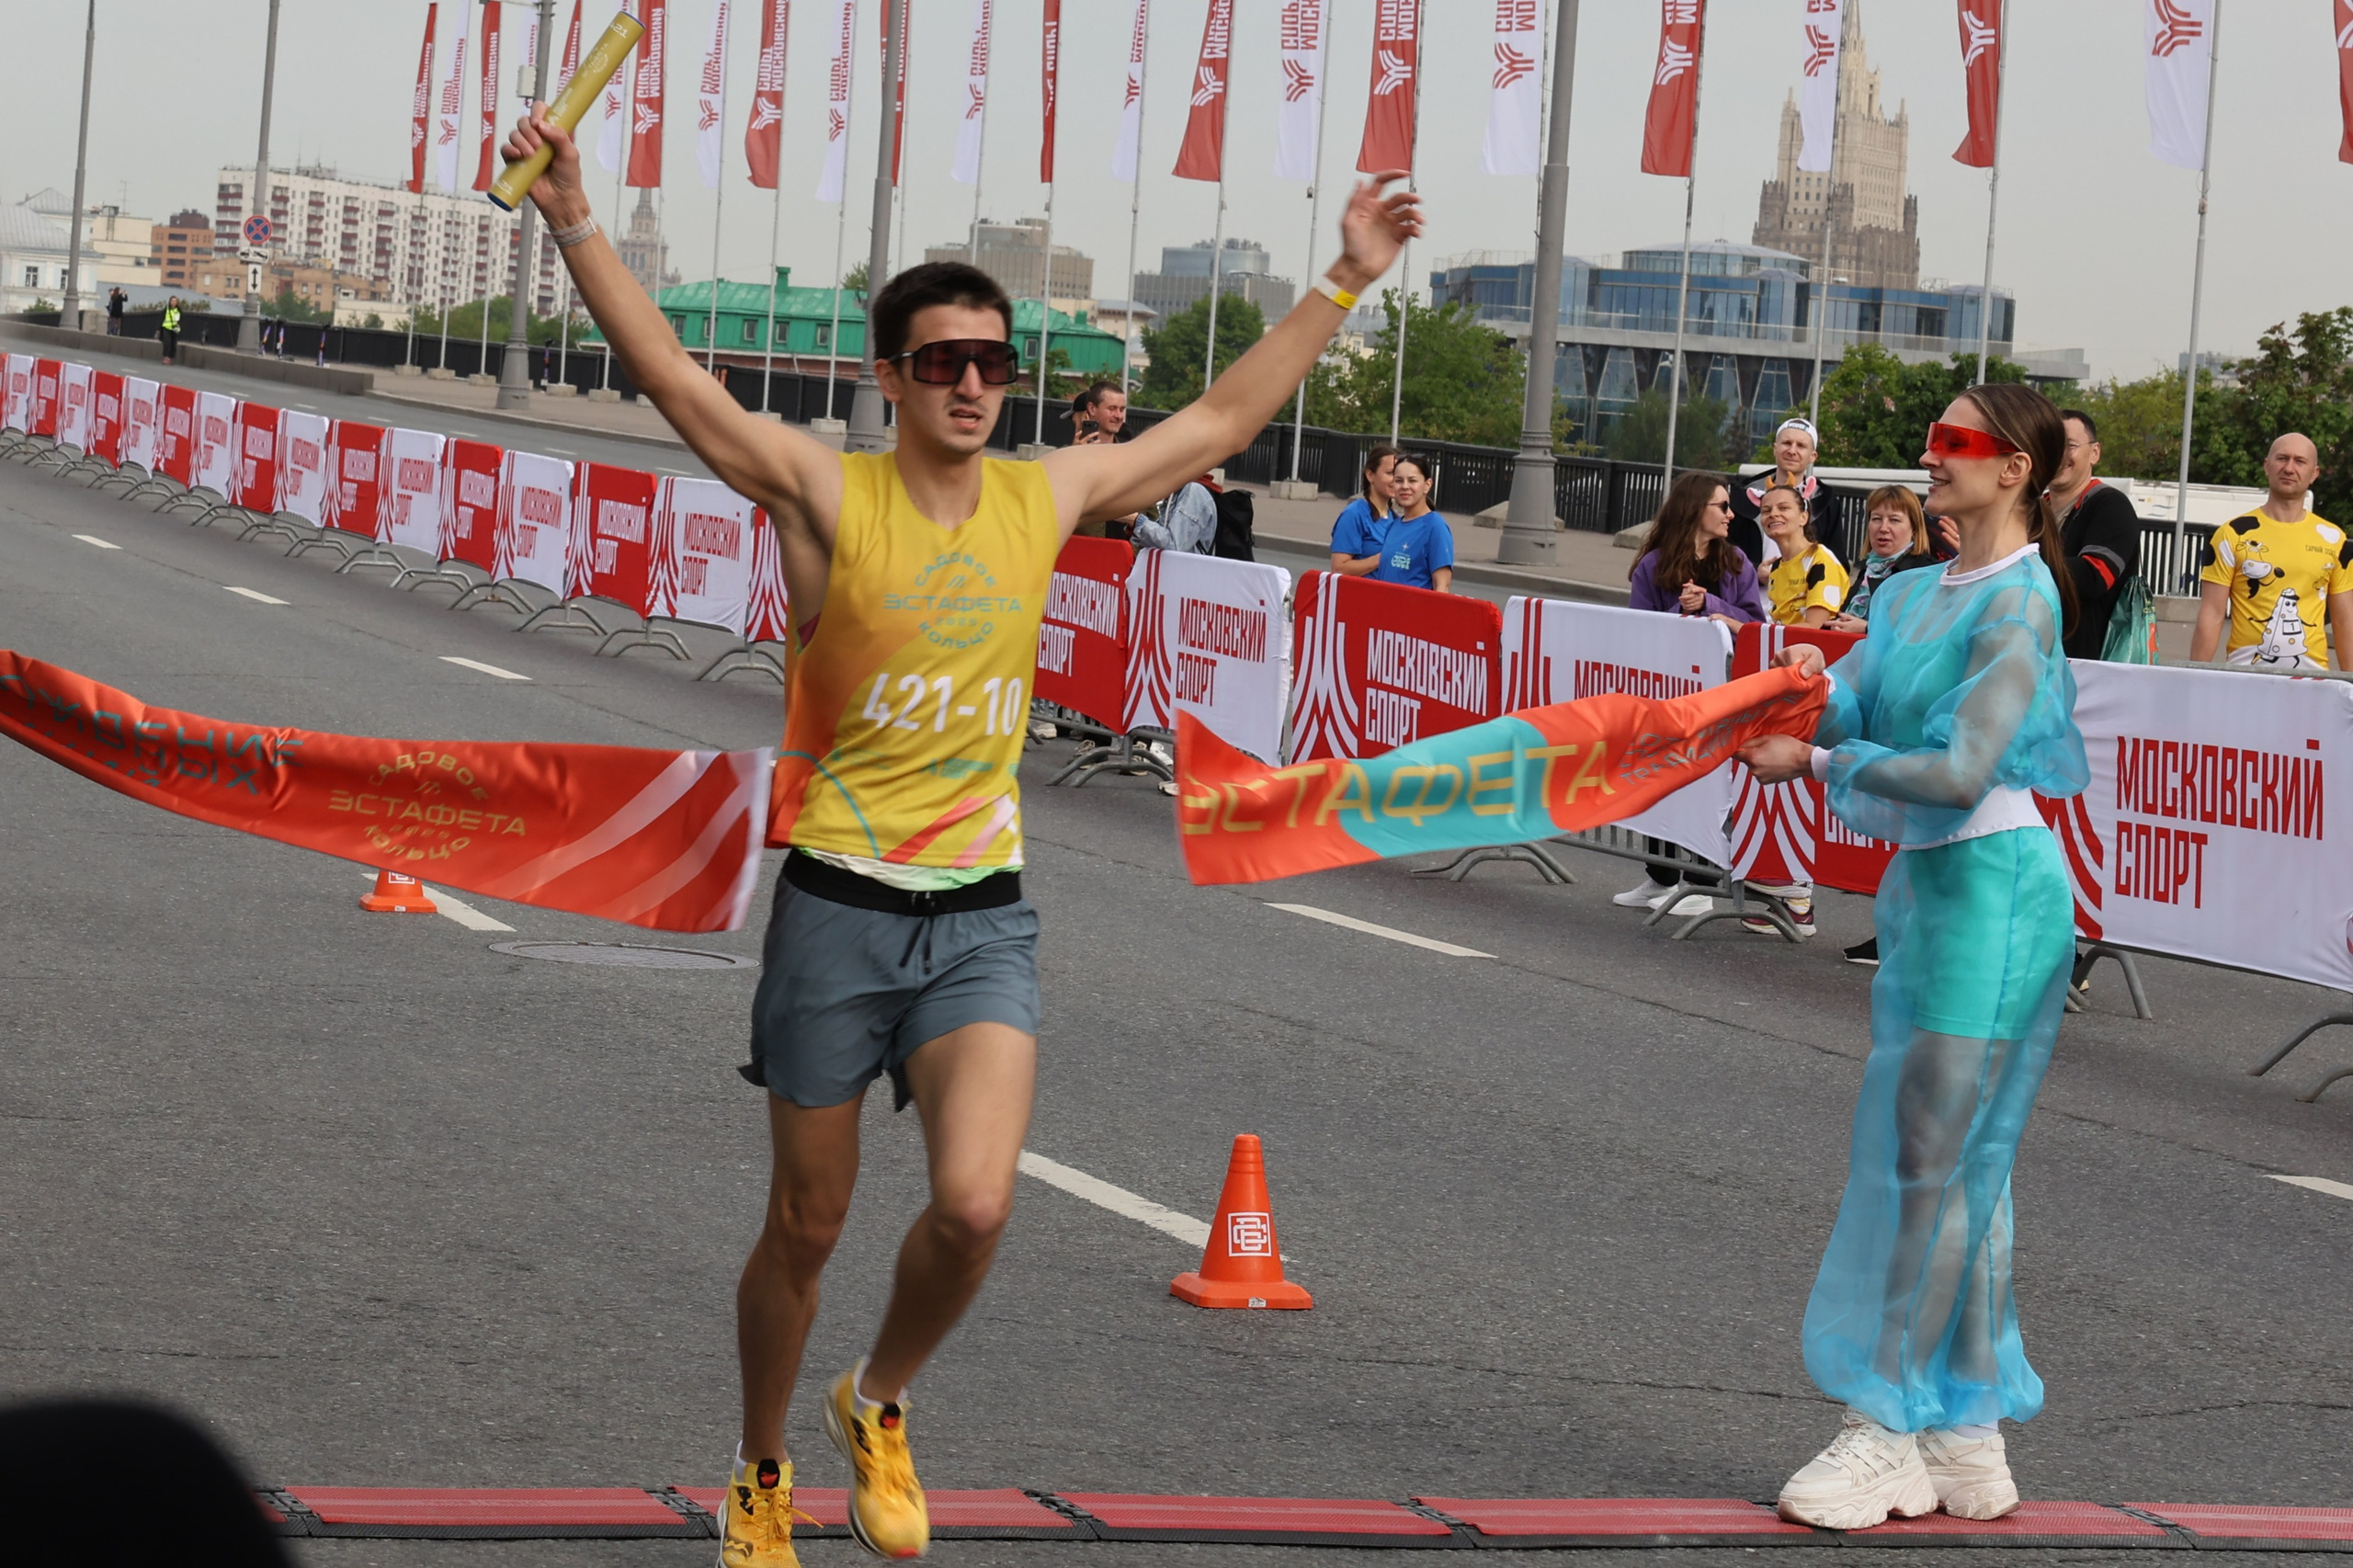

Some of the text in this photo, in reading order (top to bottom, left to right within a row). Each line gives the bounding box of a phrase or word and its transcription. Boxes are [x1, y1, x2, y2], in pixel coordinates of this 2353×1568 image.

[883, 593, 1023, 613] ЭСТАФЕТА
[1178, 597, 1267, 664] МОСКОВСКИЙ
[918, 621, 995, 649] КОЛЬЦО
[1038, 622, 1075, 677] СПОРТ
[1176, 652, 1217, 707] СПОРТ
[1367, 628, 1487, 716] МОСКОВСКИЙ
[862, 672, 1023, 736] 421-10
[1365, 687, 1421, 747] СПОРТ
[369, 751, 490, 801] САДОВОЕ
[1182, 741, 1616, 835] ЭСТАФЕТА
[2116, 736, 2324, 841] МОСКОВСКИЙ
[328, 789, 527, 837] ЭСТАФЕТА
[2115, 821, 2208, 909] СПОРТ
